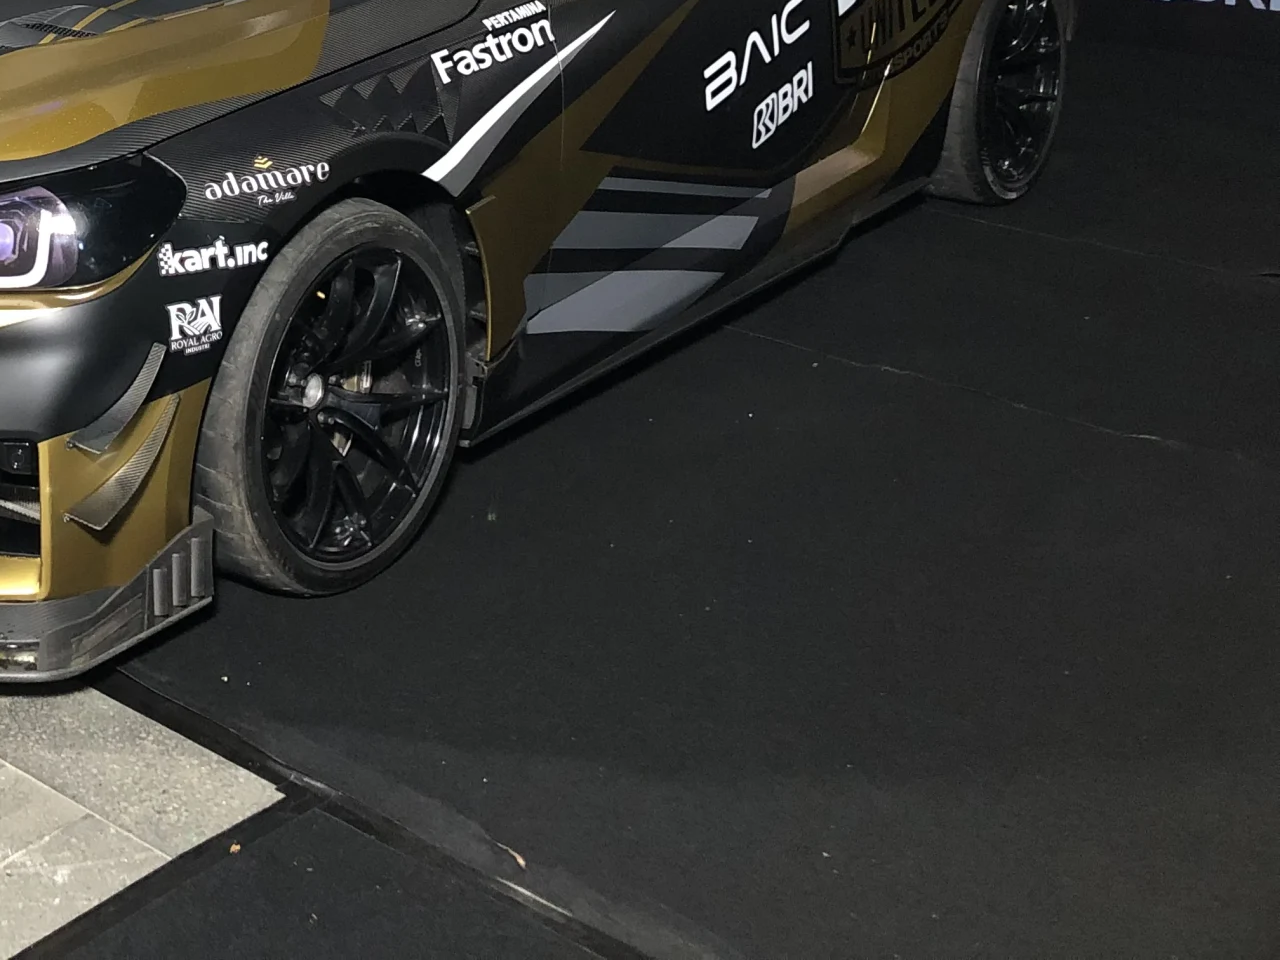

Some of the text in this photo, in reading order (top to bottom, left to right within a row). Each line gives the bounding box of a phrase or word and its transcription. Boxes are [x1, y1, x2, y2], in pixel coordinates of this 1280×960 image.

[482, 0, 546, 32] PERTAMINA
[431, 17, 556, 84] Fastron
[777, 61, 814, 129] BRI
[205, 162, 330, 200] adamare
[256, 195, 273, 206] The
[160, 240, 269, 276] kart.inc
[171, 330, 223, 351] ROYAL AGRO
